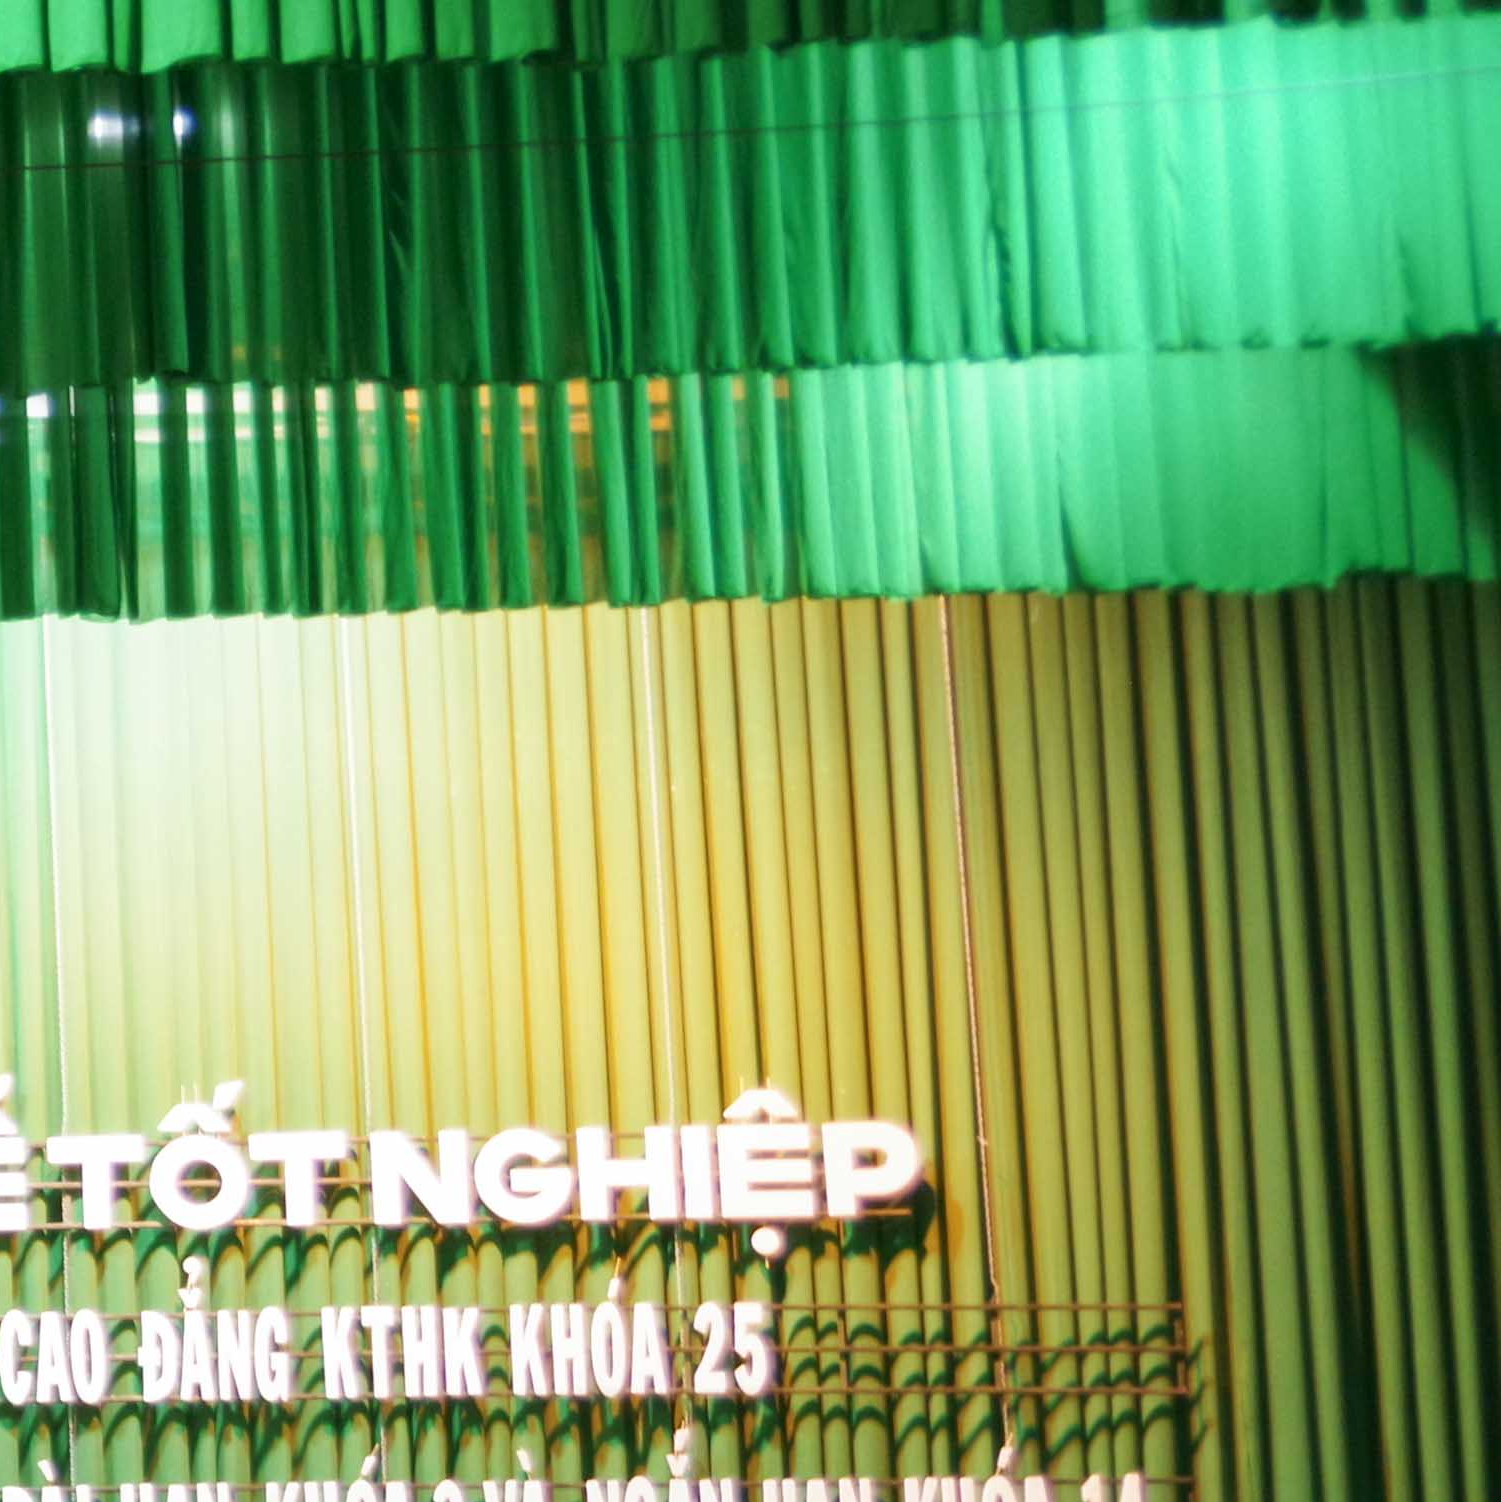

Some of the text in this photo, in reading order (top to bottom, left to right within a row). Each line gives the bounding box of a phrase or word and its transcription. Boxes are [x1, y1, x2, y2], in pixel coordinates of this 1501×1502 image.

[46, 1080, 349, 1230] TỐT
[370, 1088, 925, 1259] NGHIỆP
[138, 1257, 289, 1403] ĐẲNG
[320, 1305, 486, 1399] KTHK
[508, 1276, 672, 1399] KHÓA
[692, 1301, 776, 1396] 25
